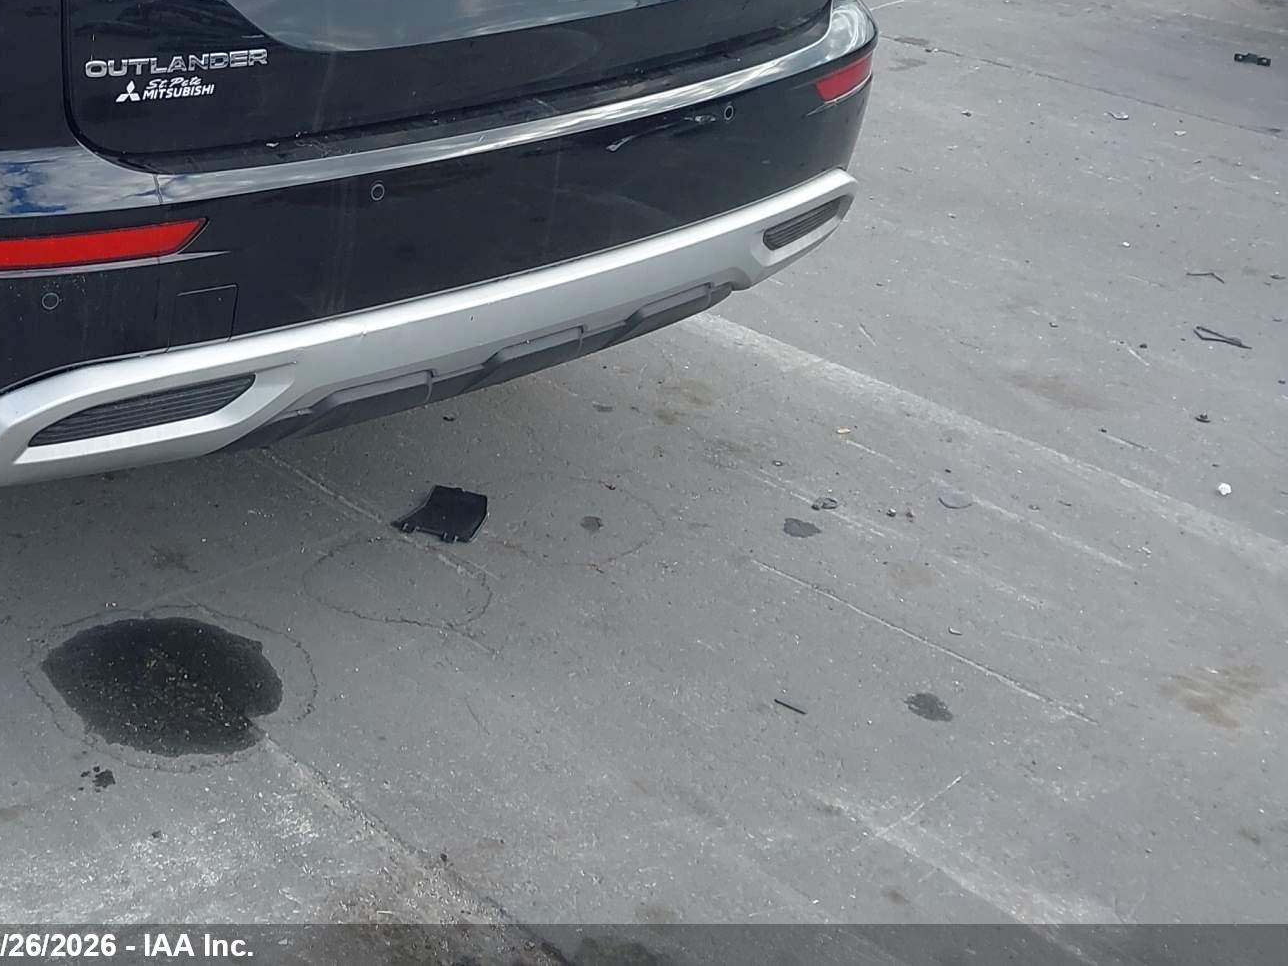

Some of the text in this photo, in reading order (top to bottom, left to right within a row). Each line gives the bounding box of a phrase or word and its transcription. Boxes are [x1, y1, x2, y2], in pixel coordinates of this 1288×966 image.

[84, 47, 268, 78] OUTLANDER
[169, 76, 202, 88] Pete
[142, 84, 215, 101] MITSUBISHI
